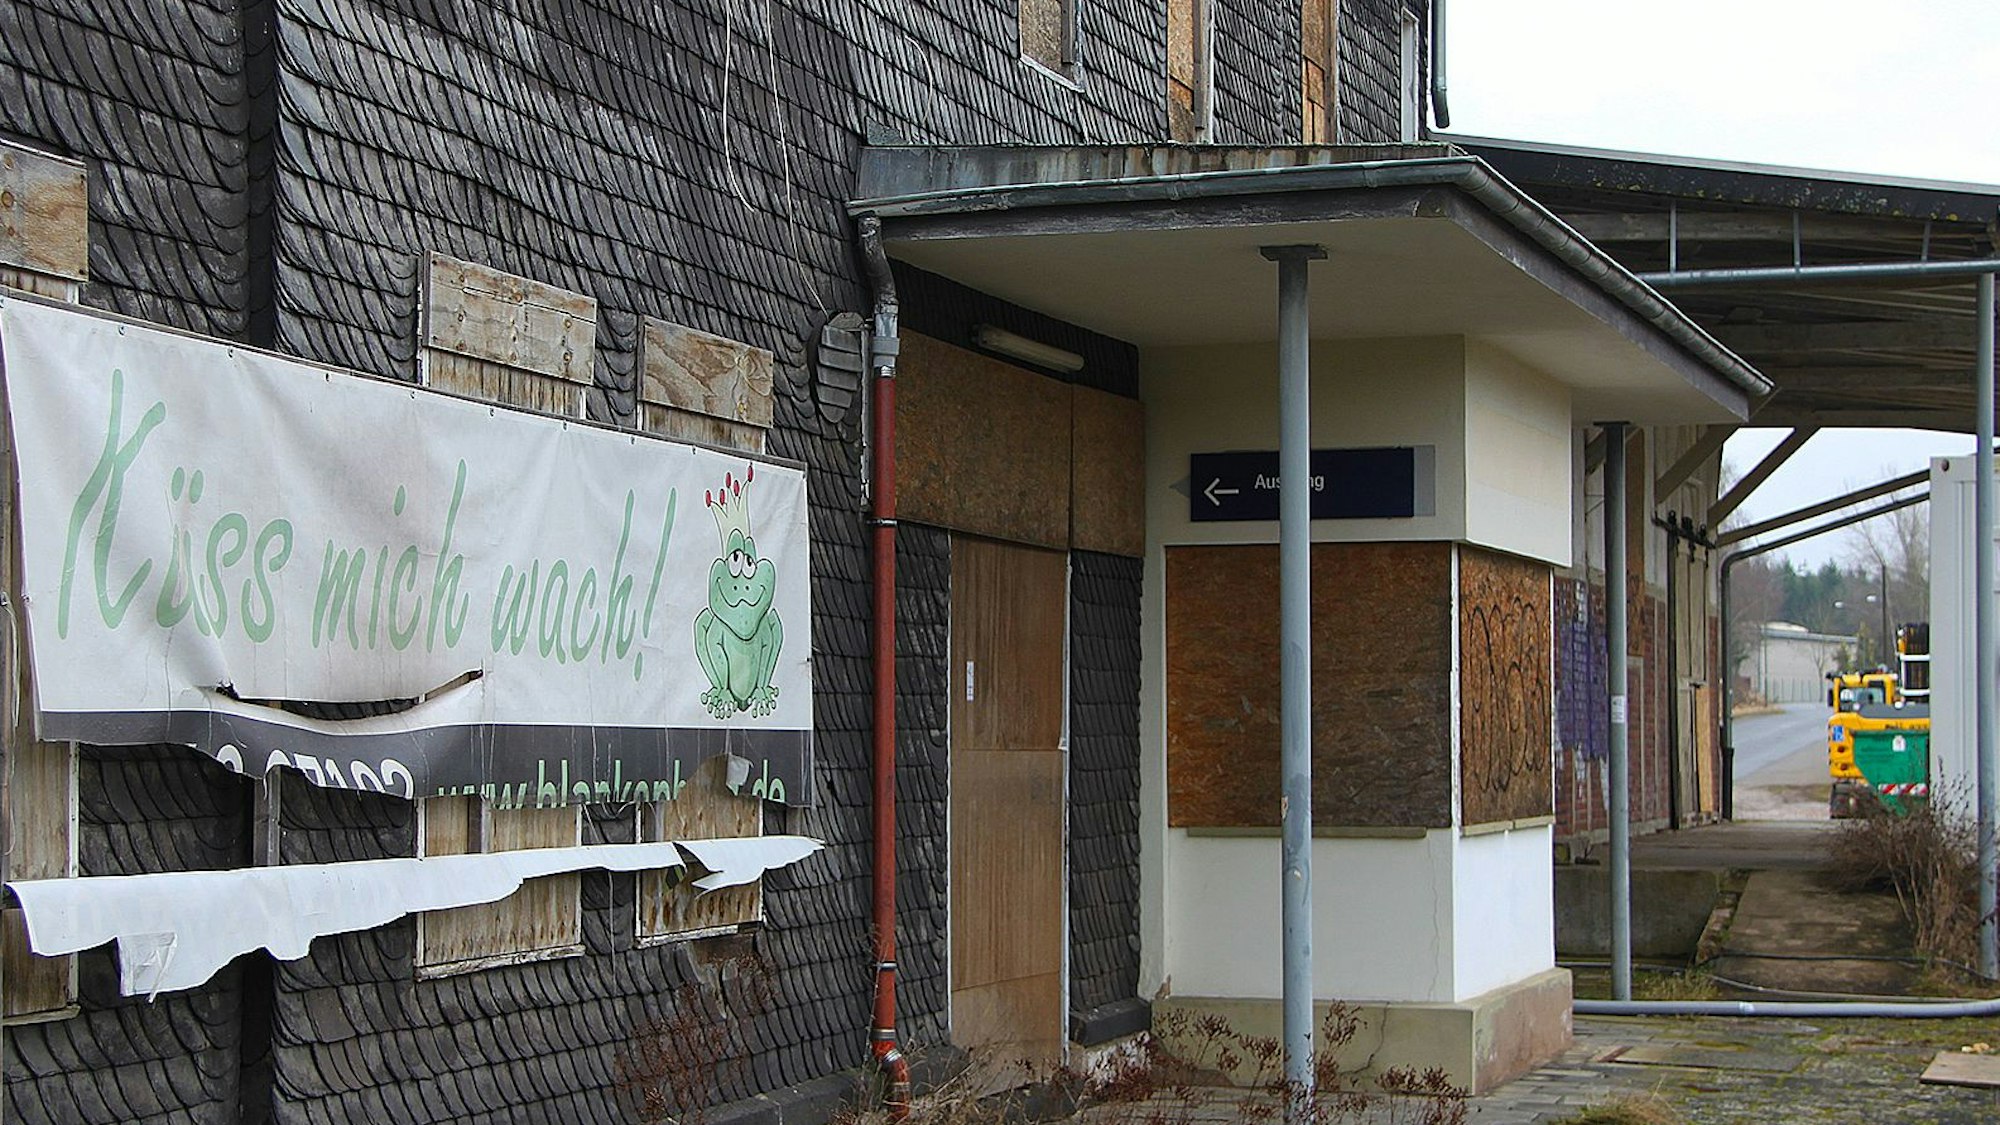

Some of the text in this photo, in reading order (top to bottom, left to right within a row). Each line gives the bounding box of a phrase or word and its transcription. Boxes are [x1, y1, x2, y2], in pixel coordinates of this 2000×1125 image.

[57, 368, 677, 682] Küss mich wach!
[1254, 473, 1325, 492] Ausng
